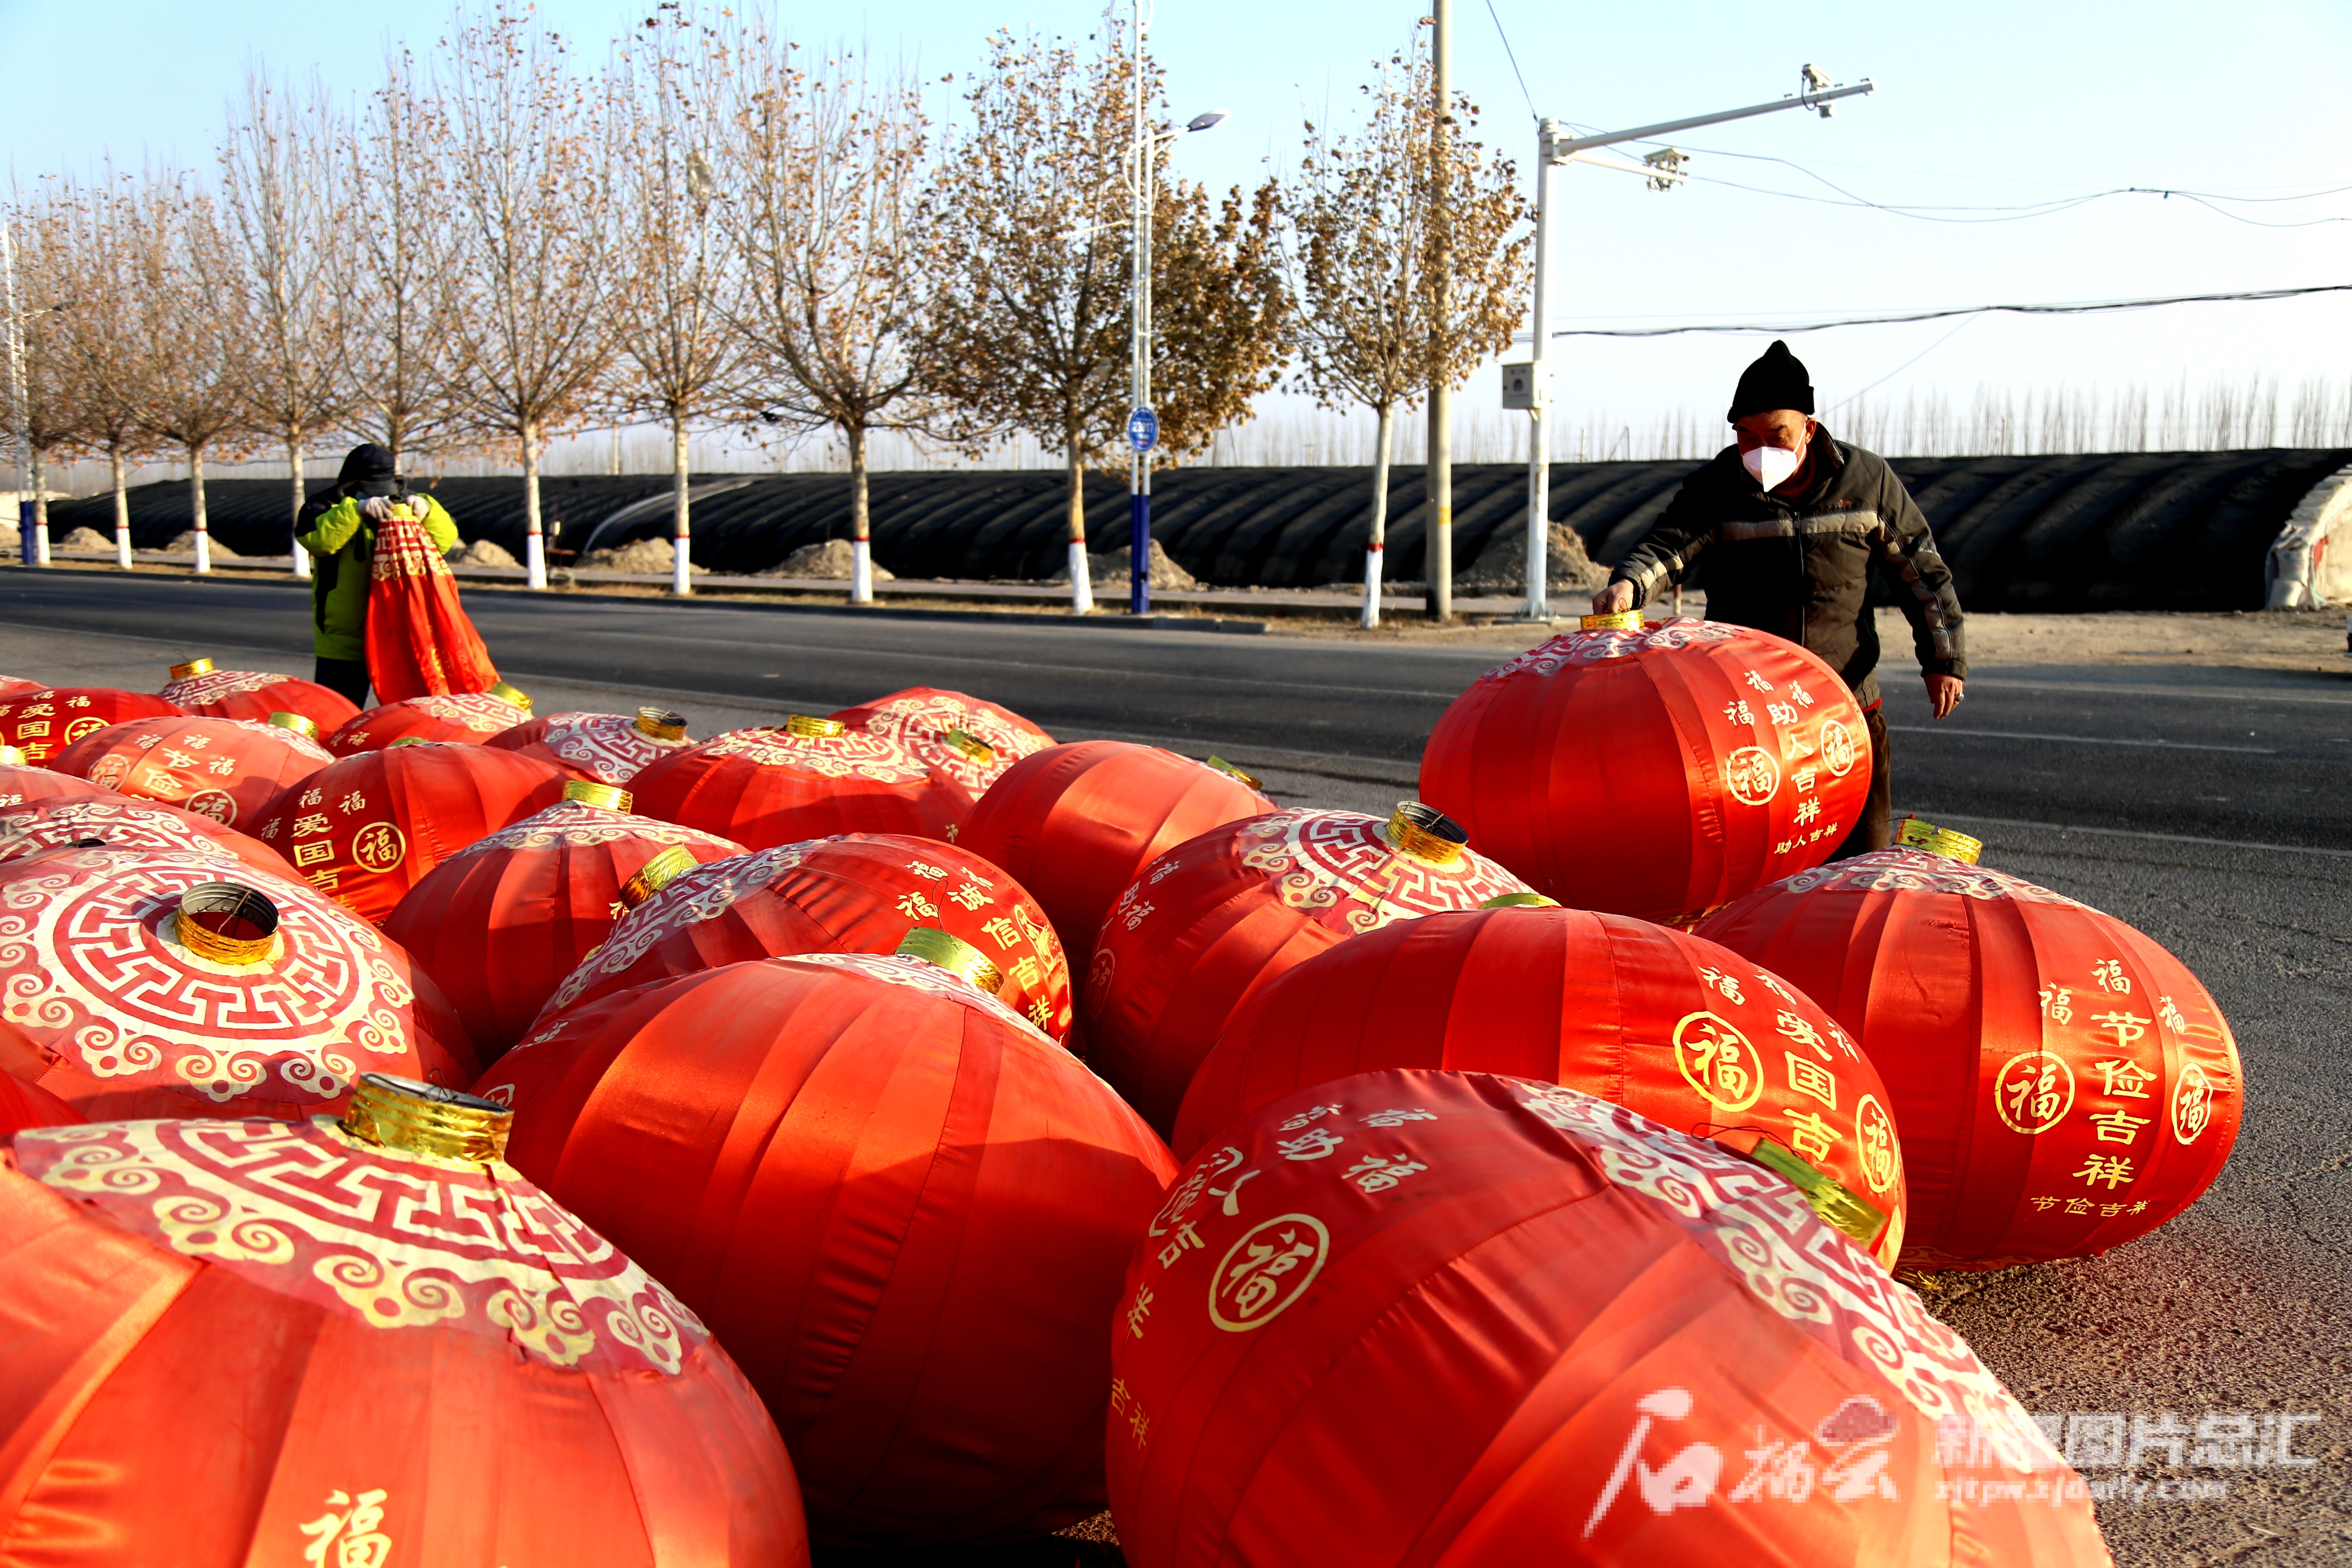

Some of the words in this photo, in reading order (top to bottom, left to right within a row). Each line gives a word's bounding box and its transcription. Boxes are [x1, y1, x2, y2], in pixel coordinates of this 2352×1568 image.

[1743, 670, 1774, 694] 福
[1788, 680, 1814, 708] 福
[66, 696, 91, 708] 福
[1722, 700, 1755, 726] 福
[17, 704, 56, 769] 爱国吉
[135, 734, 163, 749] 福
[184, 734, 211, 750] 福
[1825, 726, 1850, 770] 福
[131, 748, 200, 801] 节俭
[209, 756, 236, 776] 福
[1733, 752, 1773, 798] 福
[1766, 701, 1821, 827] 助人吉祥
[298, 787, 322, 808] 福
[339, 790, 366, 815] 福
[261, 818, 282, 840] 福
[360, 827, 397, 866] 福
[1774, 822, 1838, 854] 助人吉祥
[905, 861, 949, 881] 福
[894, 891, 939, 921] 福
[1123, 900, 1155, 931] 福
[947, 882, 1054, 1031] 诚信吉祥
[1698, 966, 1746, 1005] 福
[2090, 958, 2131, 995] 福
[2038, 981, 2073, 1026] 福
[2159, 995, 2185, 1034] 福
[1685, 1023, 1749, 1099] 福
[1776, 1008, 1843, 1161] 爱国吉
[2006, 1063, 2061, 1122] 福
[2072, 1011, 2157, 1190] 节俭吉祥
[1341, 1152, 1428, 1194] 福
[2030, 1196, 2150, 1217] 节俭吉祥
[1222, 1228, 1315, 1319] 福
[300, 1488, 392, 1568] 福
